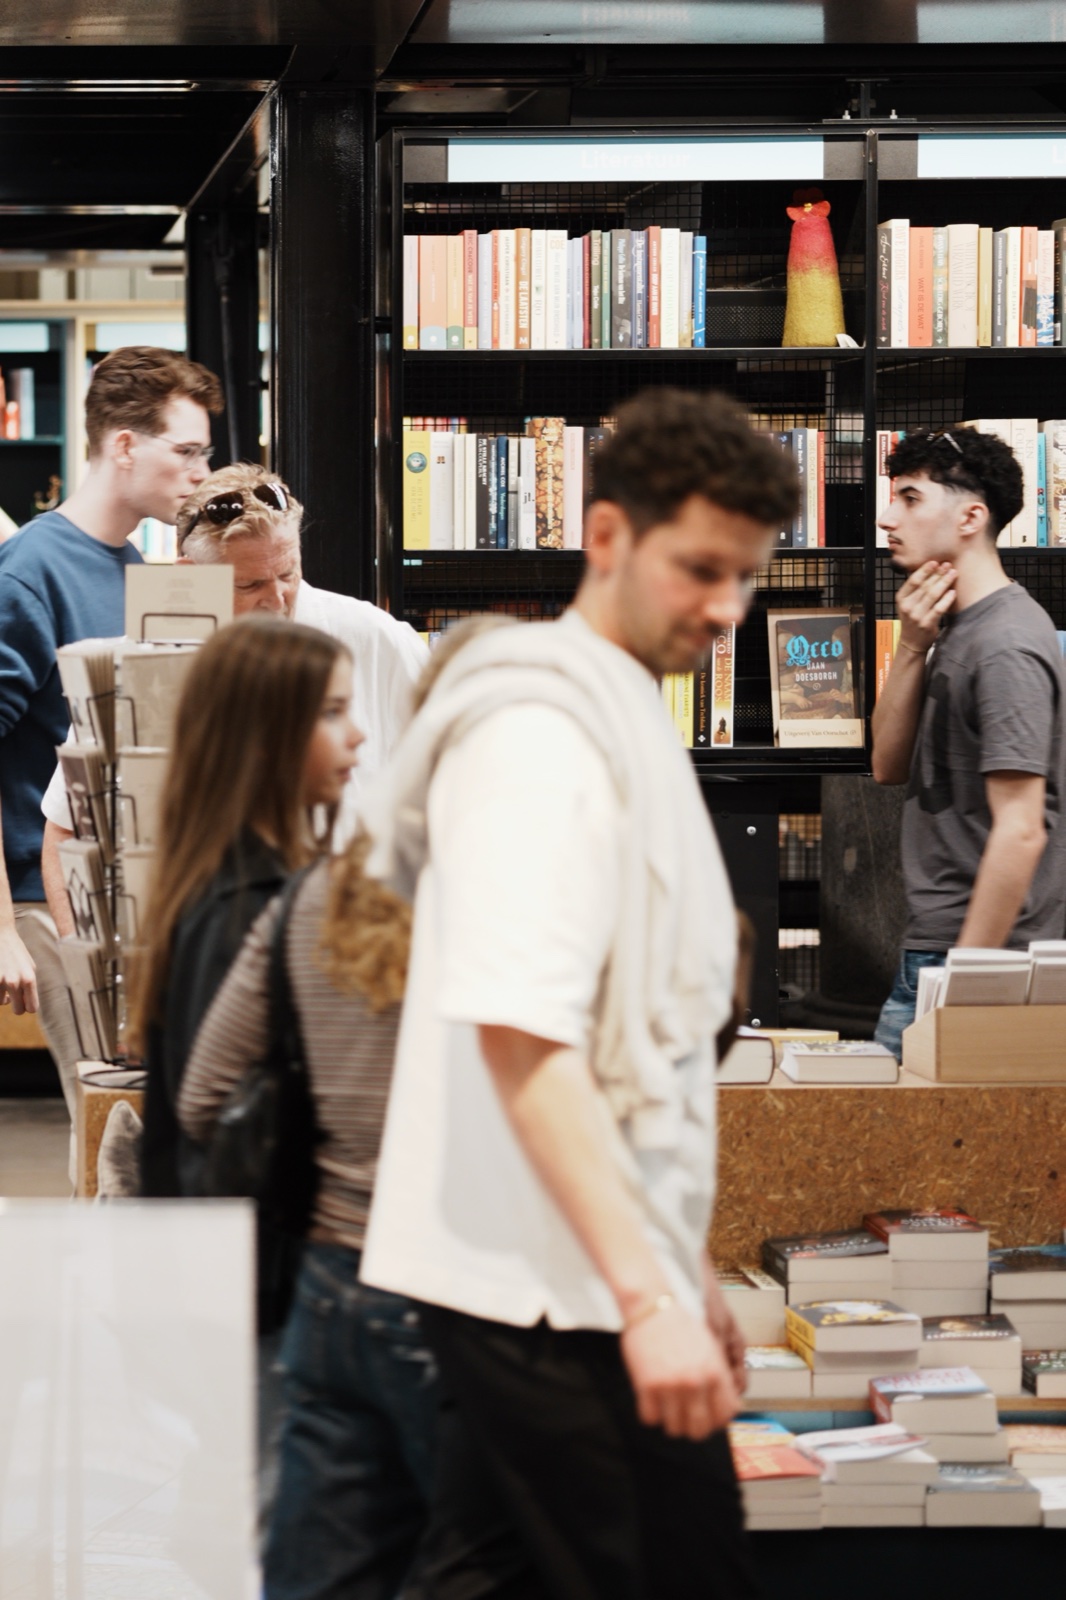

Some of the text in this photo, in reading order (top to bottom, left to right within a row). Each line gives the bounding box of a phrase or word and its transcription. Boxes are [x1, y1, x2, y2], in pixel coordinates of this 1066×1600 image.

[581, 150, 690, 169] Literatuur
[592, 239, 600, 266] Trilling
[636, 239, 644, 248] De
[520, 281, 528, 291] DE
[520, 292, 528, 329] LAATSTEN
[918, 303, 925, 312] DE
[1026, 440, 1034, 459] KEN
[1037, 488, 1046, 525] RUST
[700, 672, 707, 680] De
[807, 662, 825, 671] DAAN
[724, 657, 732, 703] DE NAAM
[795, 672, 838, 682] DOESBORGH
[715, 673, 723, 702] ROOS
